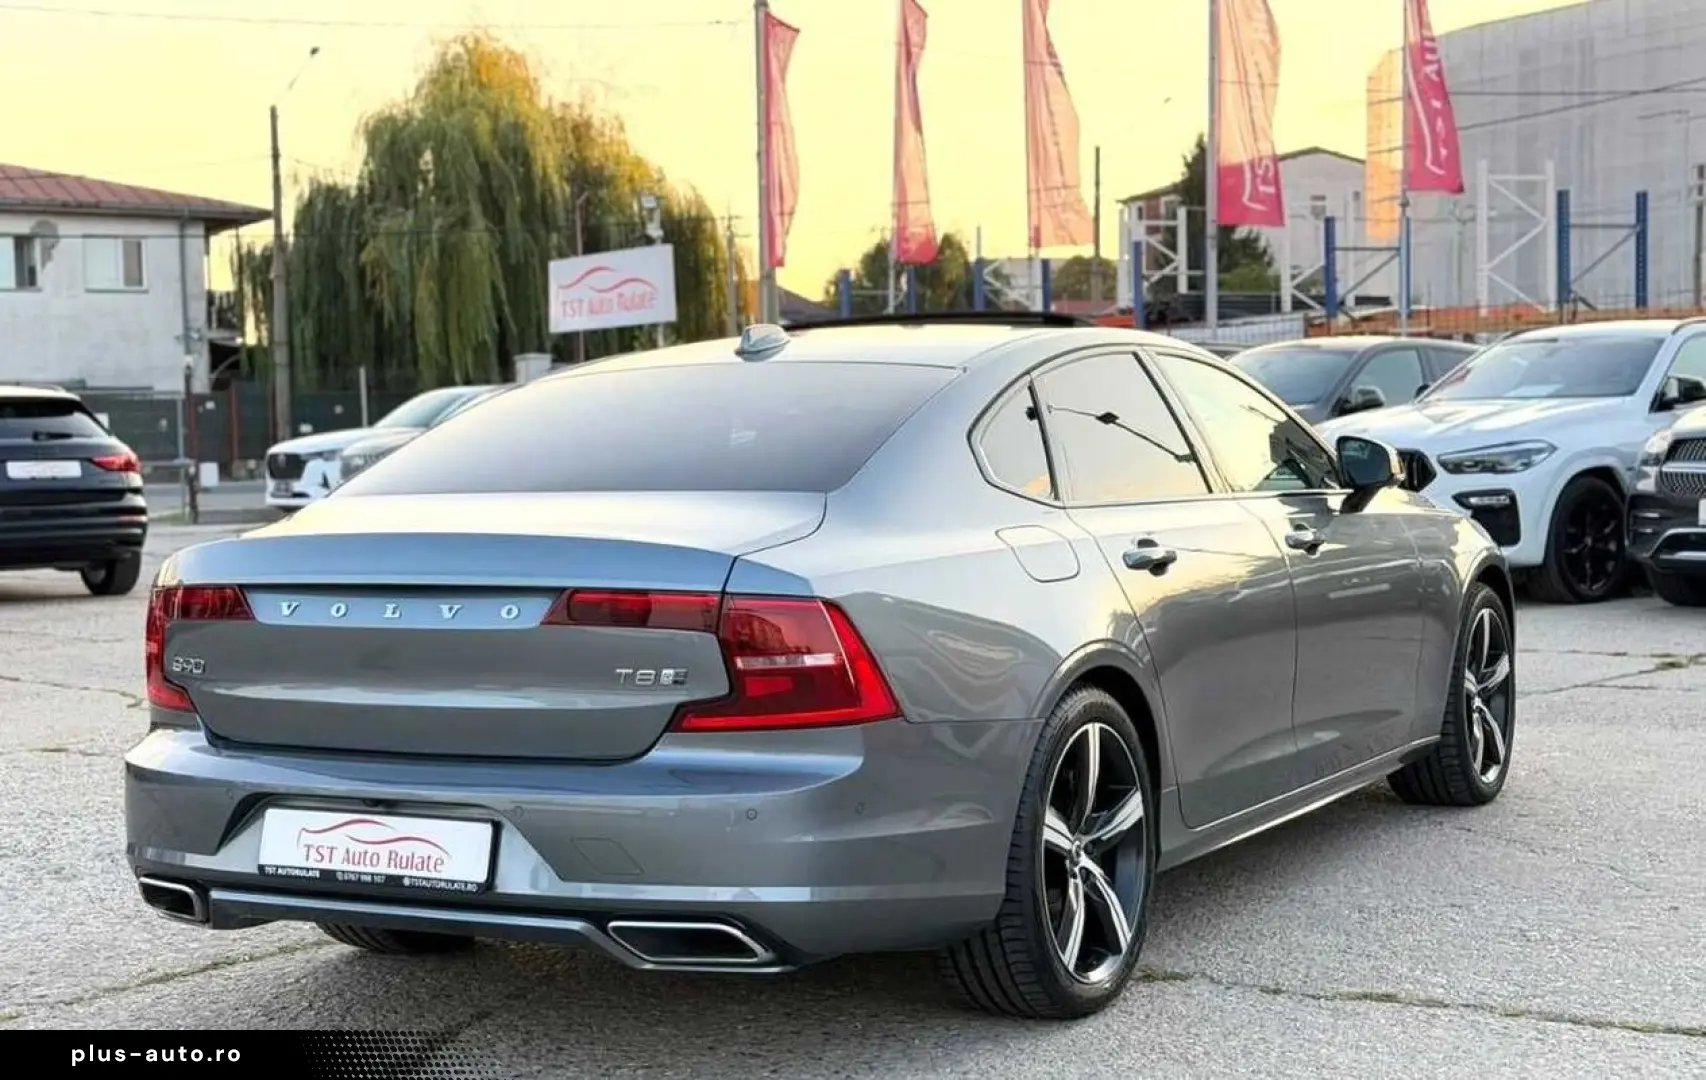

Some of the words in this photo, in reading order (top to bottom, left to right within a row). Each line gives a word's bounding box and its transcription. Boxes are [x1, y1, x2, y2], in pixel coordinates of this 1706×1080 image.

[562, 299, 585, 318] TST
[280, 600, 521, 621] VOLVO
[172, 656, 205, 674] S90
[615, 668, 656, 685] T8
[303, 844, 338, 865] TST
[341, 847, 380, 869] Auto
[387, 850, 445, 874] Rulate
